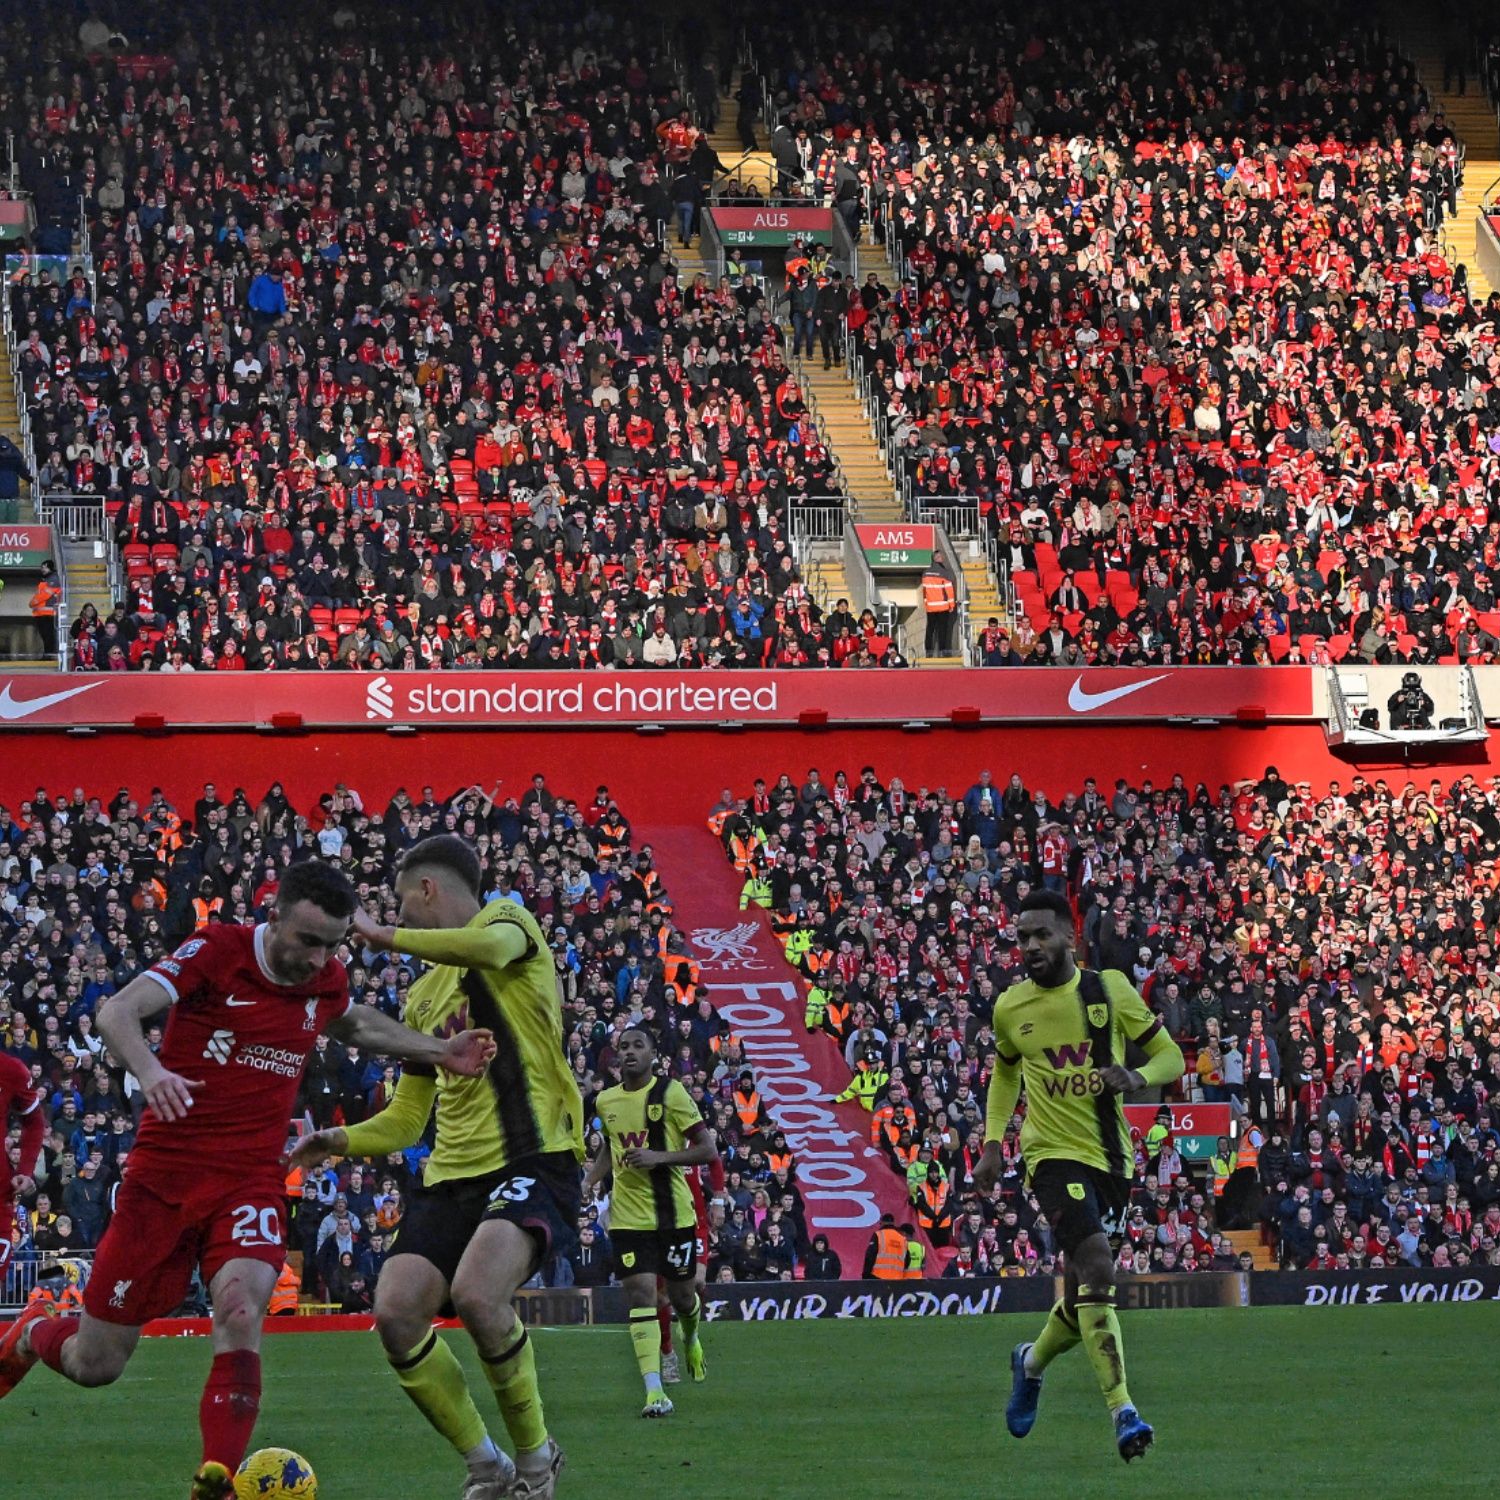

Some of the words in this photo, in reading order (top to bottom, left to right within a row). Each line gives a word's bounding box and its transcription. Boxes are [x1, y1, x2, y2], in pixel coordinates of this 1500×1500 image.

[754, 213, 789, 227] AU5
[0, 532, 30, 547] M6
[874, 531, 914, 545] AM5
[408, 682, 583, 713] standard
[593, 681, 777, 713] chartered
[240, 1043, 306, 1066] standard
[1042, 1072, 1104, 1098] W88
[704, 981, 882, 1228] Foundation
[1171, 1113, 1194, 1130] L6
[231, 1204, 281, 1245] 20
[667, 1241, 693, 1268] 47
[740, 1293, 827, 1321] YOUR
[834, 1284, 1000, 1318] KINGDOM!
